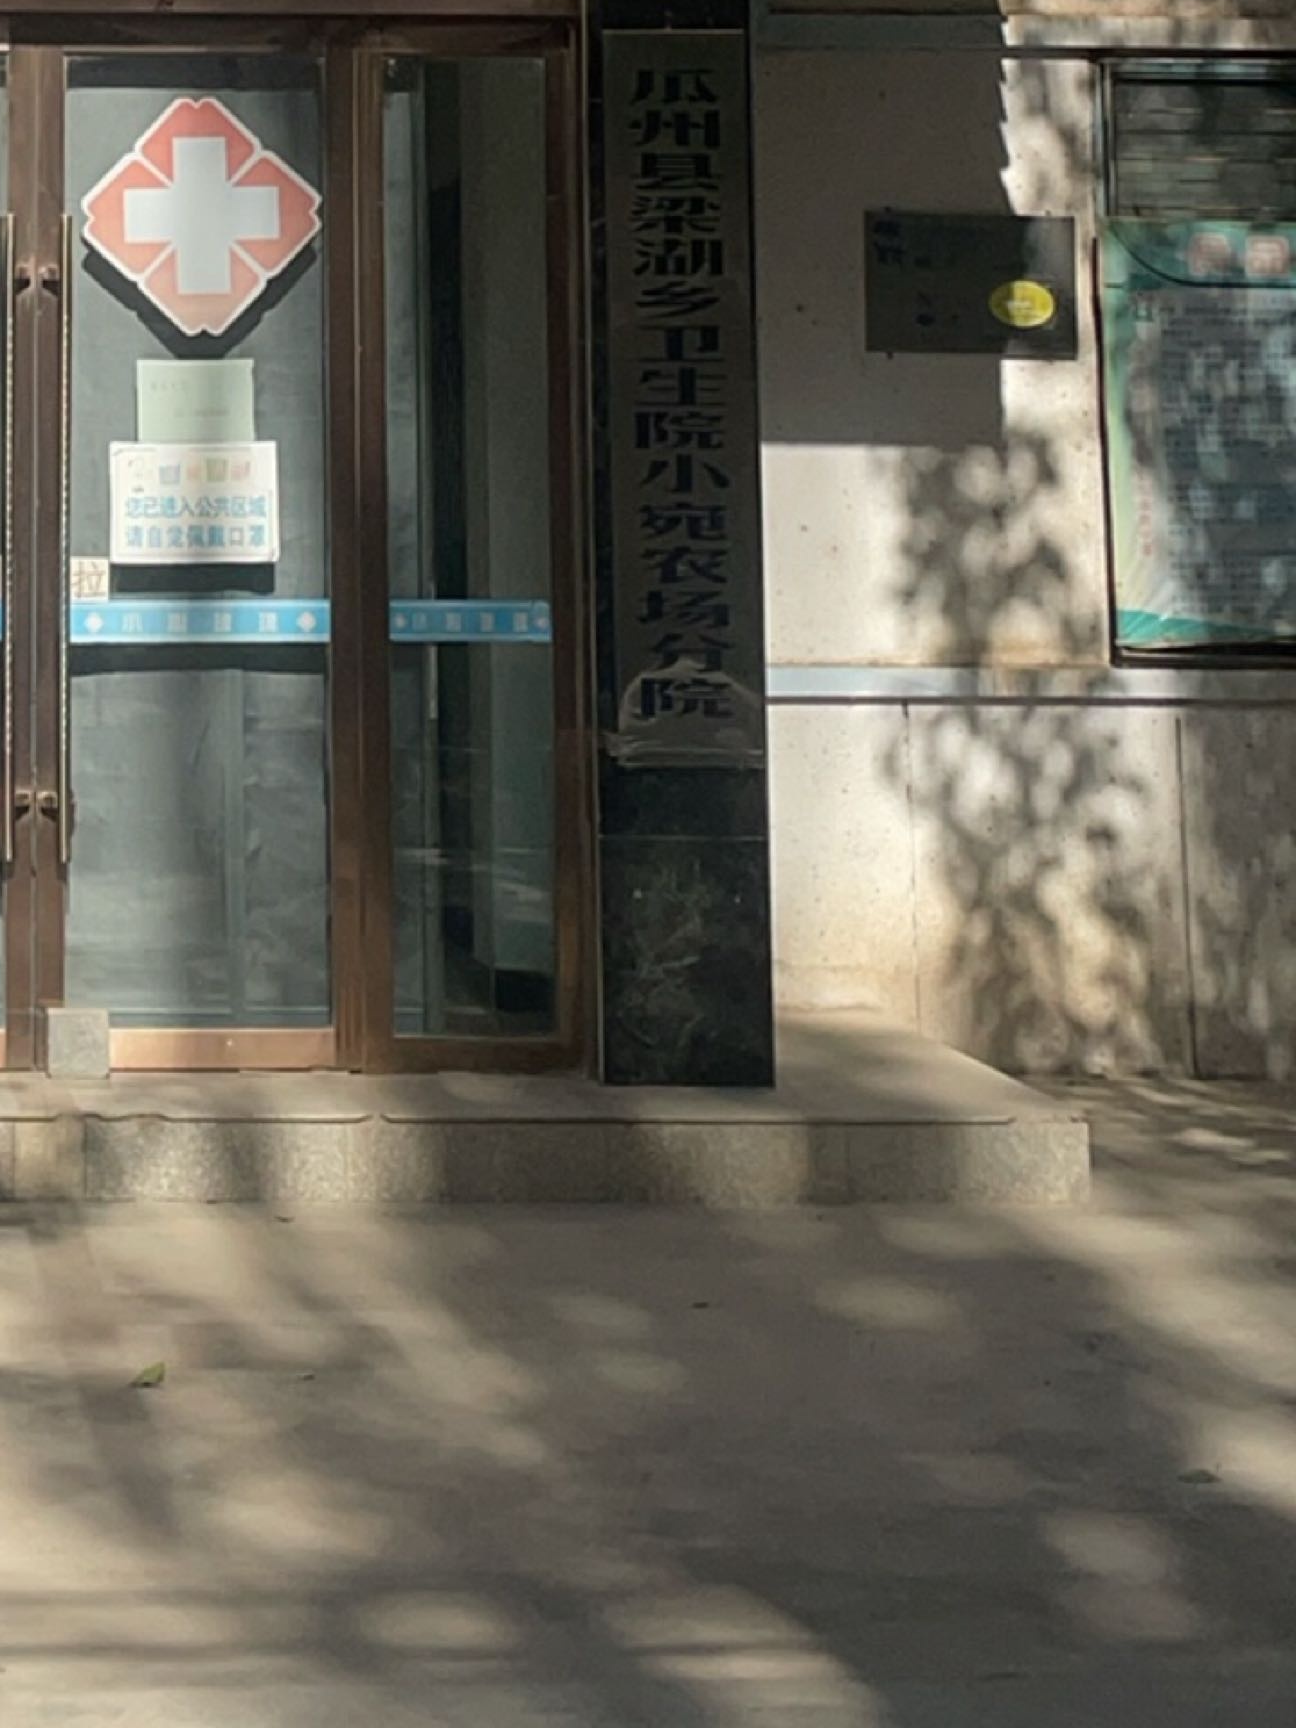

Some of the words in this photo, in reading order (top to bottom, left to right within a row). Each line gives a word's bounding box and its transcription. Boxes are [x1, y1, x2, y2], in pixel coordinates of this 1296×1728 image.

[627, 68, 735, 719] 瓜州县梁湖乡卫生院小宛农场分院
